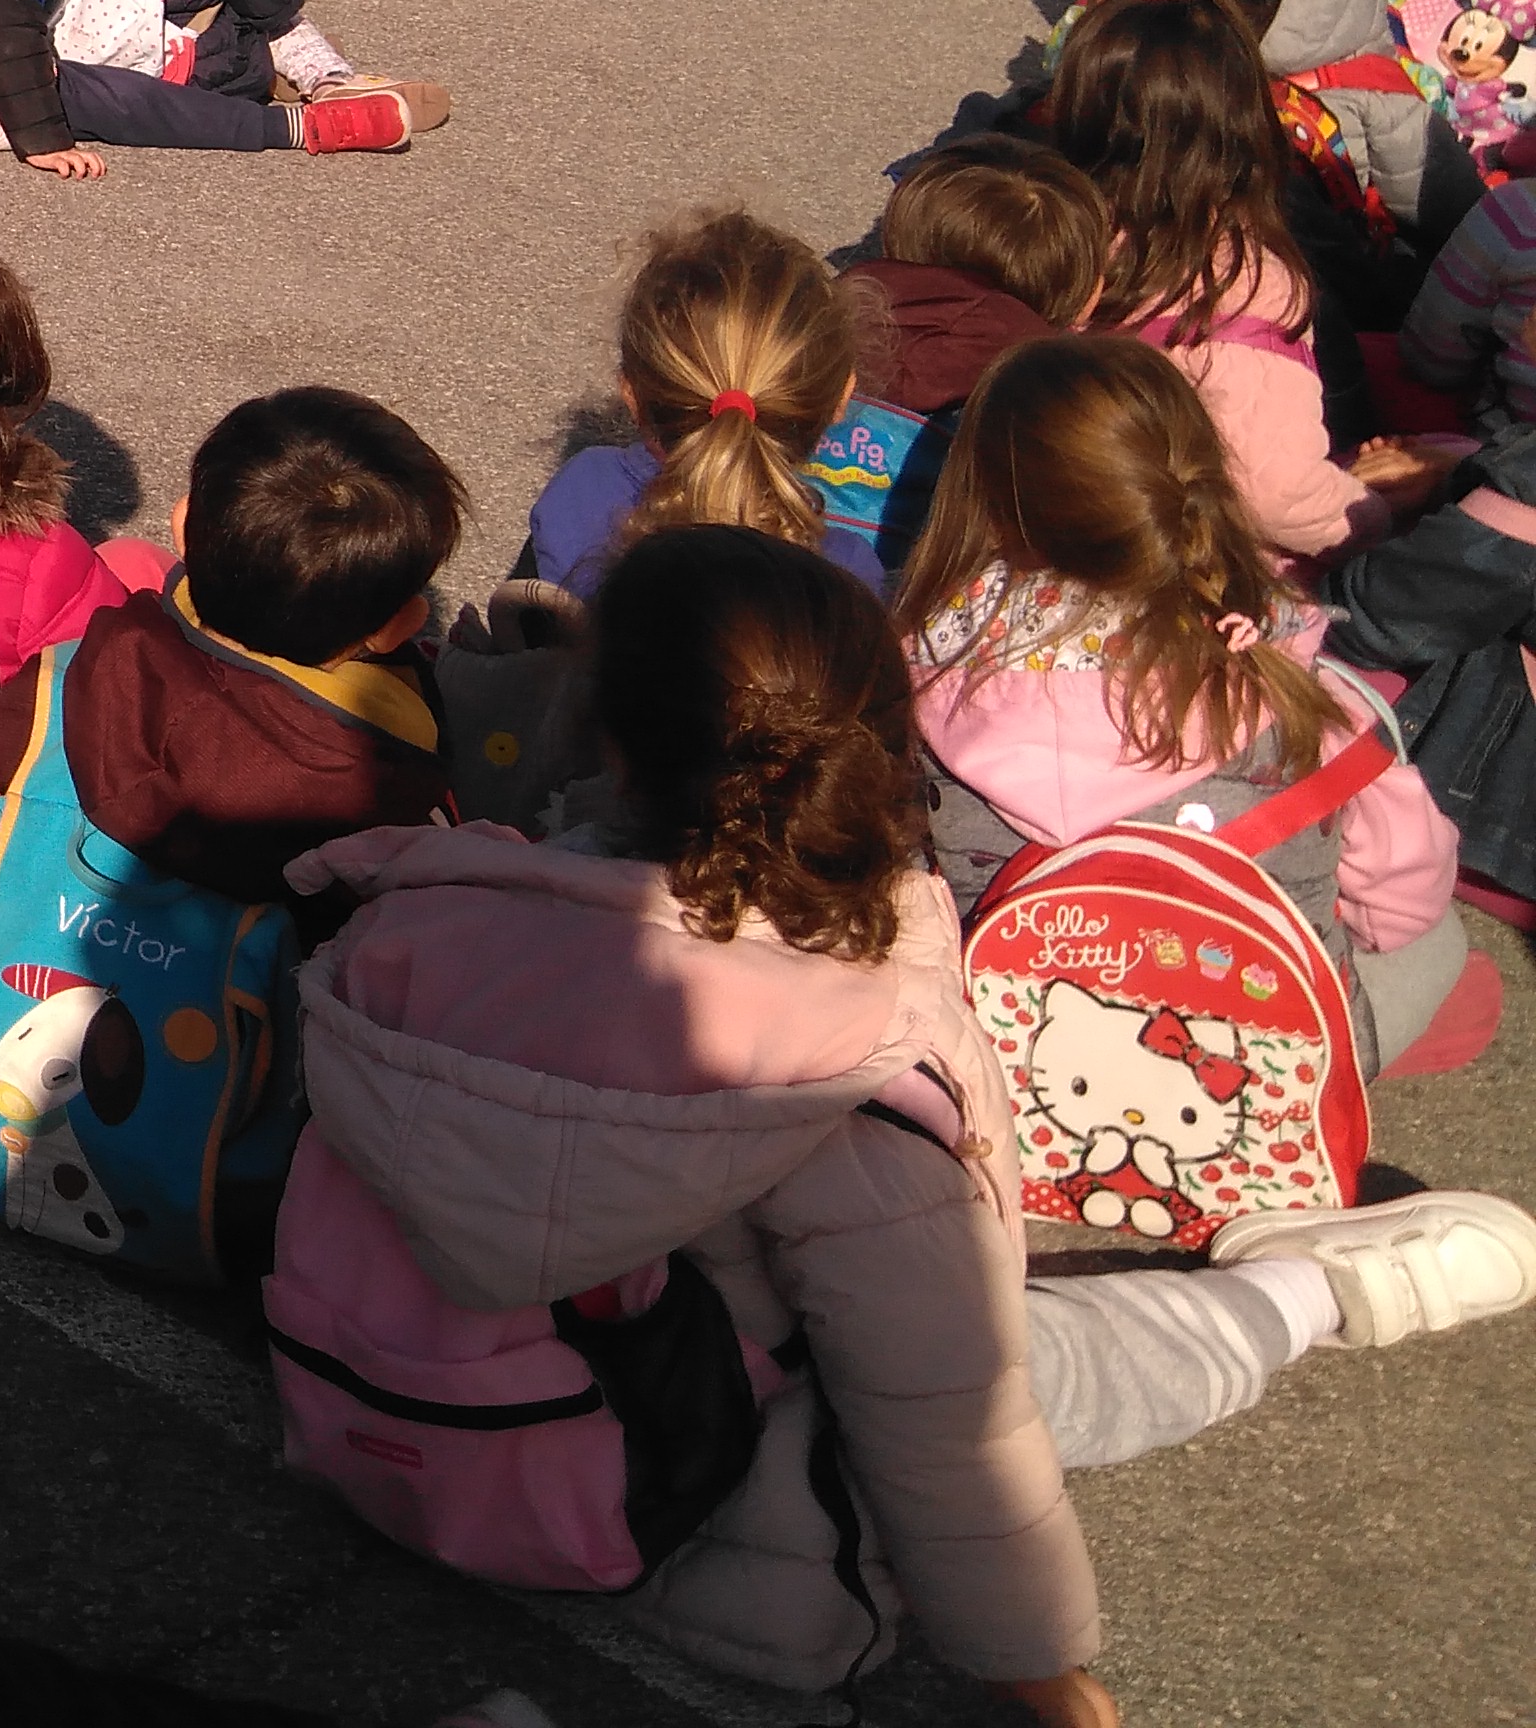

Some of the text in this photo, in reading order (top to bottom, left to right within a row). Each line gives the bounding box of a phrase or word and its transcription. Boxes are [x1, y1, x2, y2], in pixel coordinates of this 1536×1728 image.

[58, 894, 186, 971] Víctor
[999, 901, 1110, 940] Hello
[1028, 936, 1143, 985] Kitty
